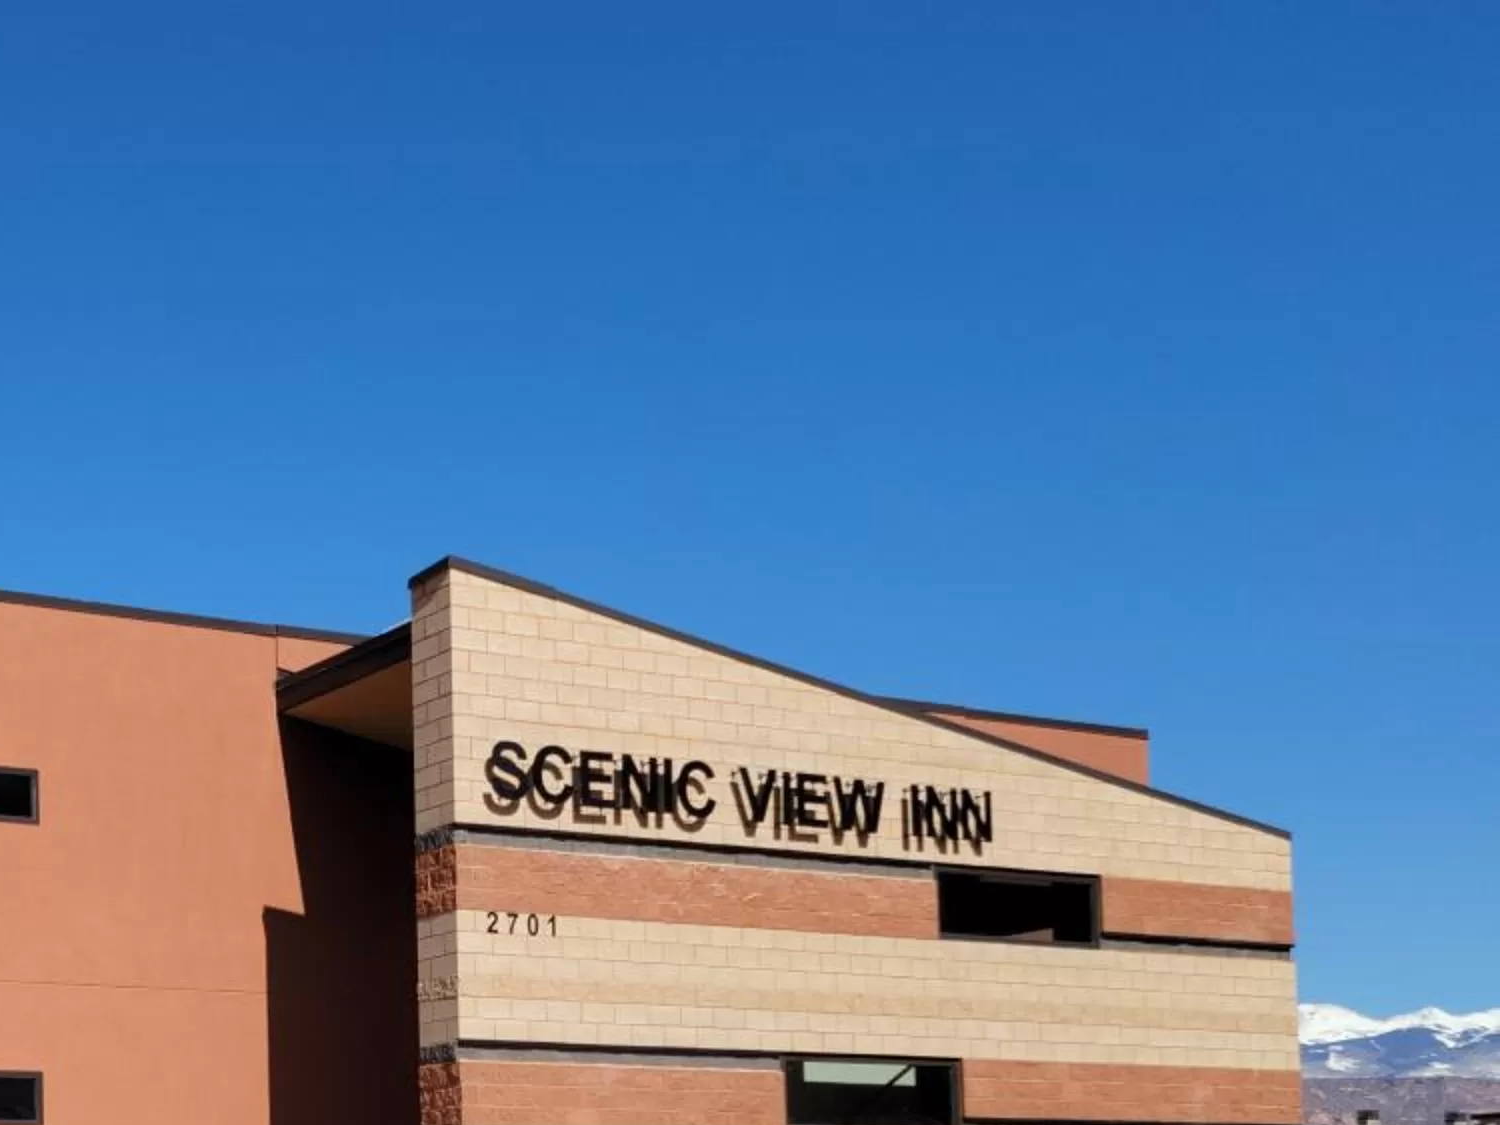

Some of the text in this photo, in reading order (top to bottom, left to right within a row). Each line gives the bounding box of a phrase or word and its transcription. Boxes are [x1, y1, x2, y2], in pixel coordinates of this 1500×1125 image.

[491, 740, 993, 843] SCENIC VIEW INN
[486, 911, 558, 937] 2701
